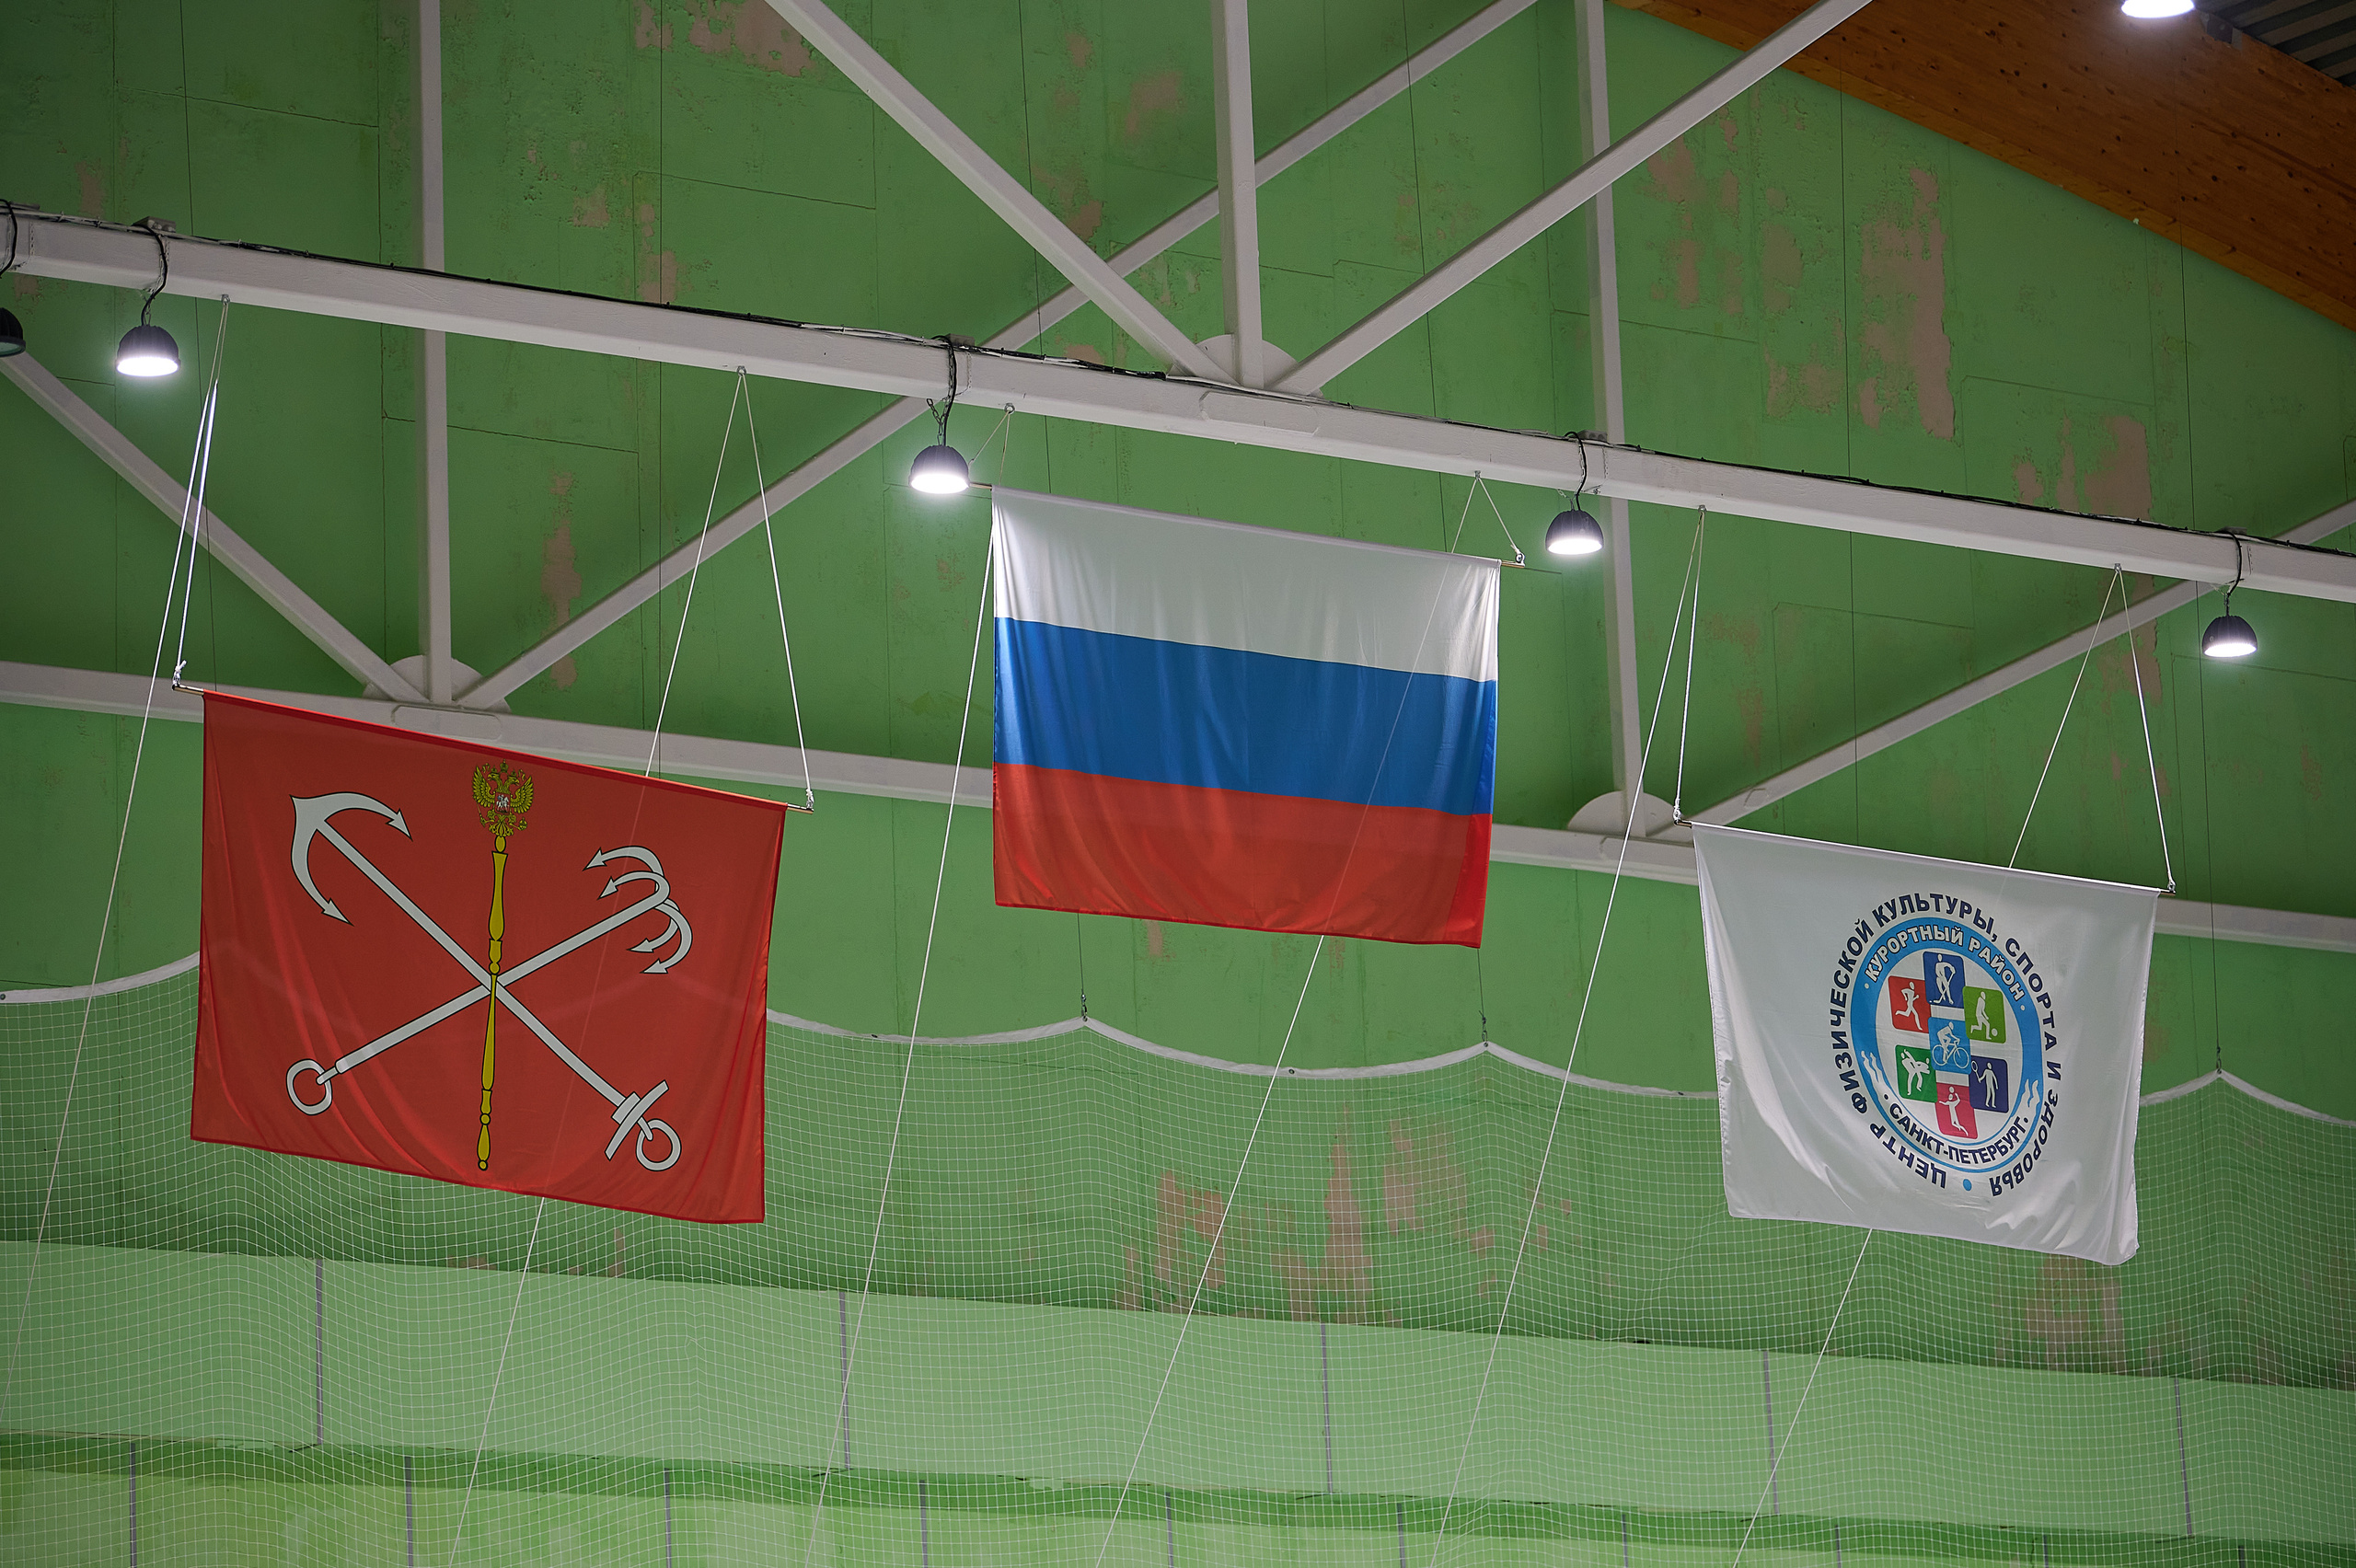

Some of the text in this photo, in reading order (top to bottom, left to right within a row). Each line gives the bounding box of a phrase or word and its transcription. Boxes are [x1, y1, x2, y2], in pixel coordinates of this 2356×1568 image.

[1864, 924, 2026, 1001] КУРОРТНЫЙ РАЙОН
[1831, 893, 2062, 1196] ЦЕНТР ФИЗИЧЕСКОЙ КУЛЬТУРЫ, СПОРТА И ЗДОРОВЬЯ
[1889, 1102, 2028, 1165] САНКТ-ПЕТЕРБУРГ
